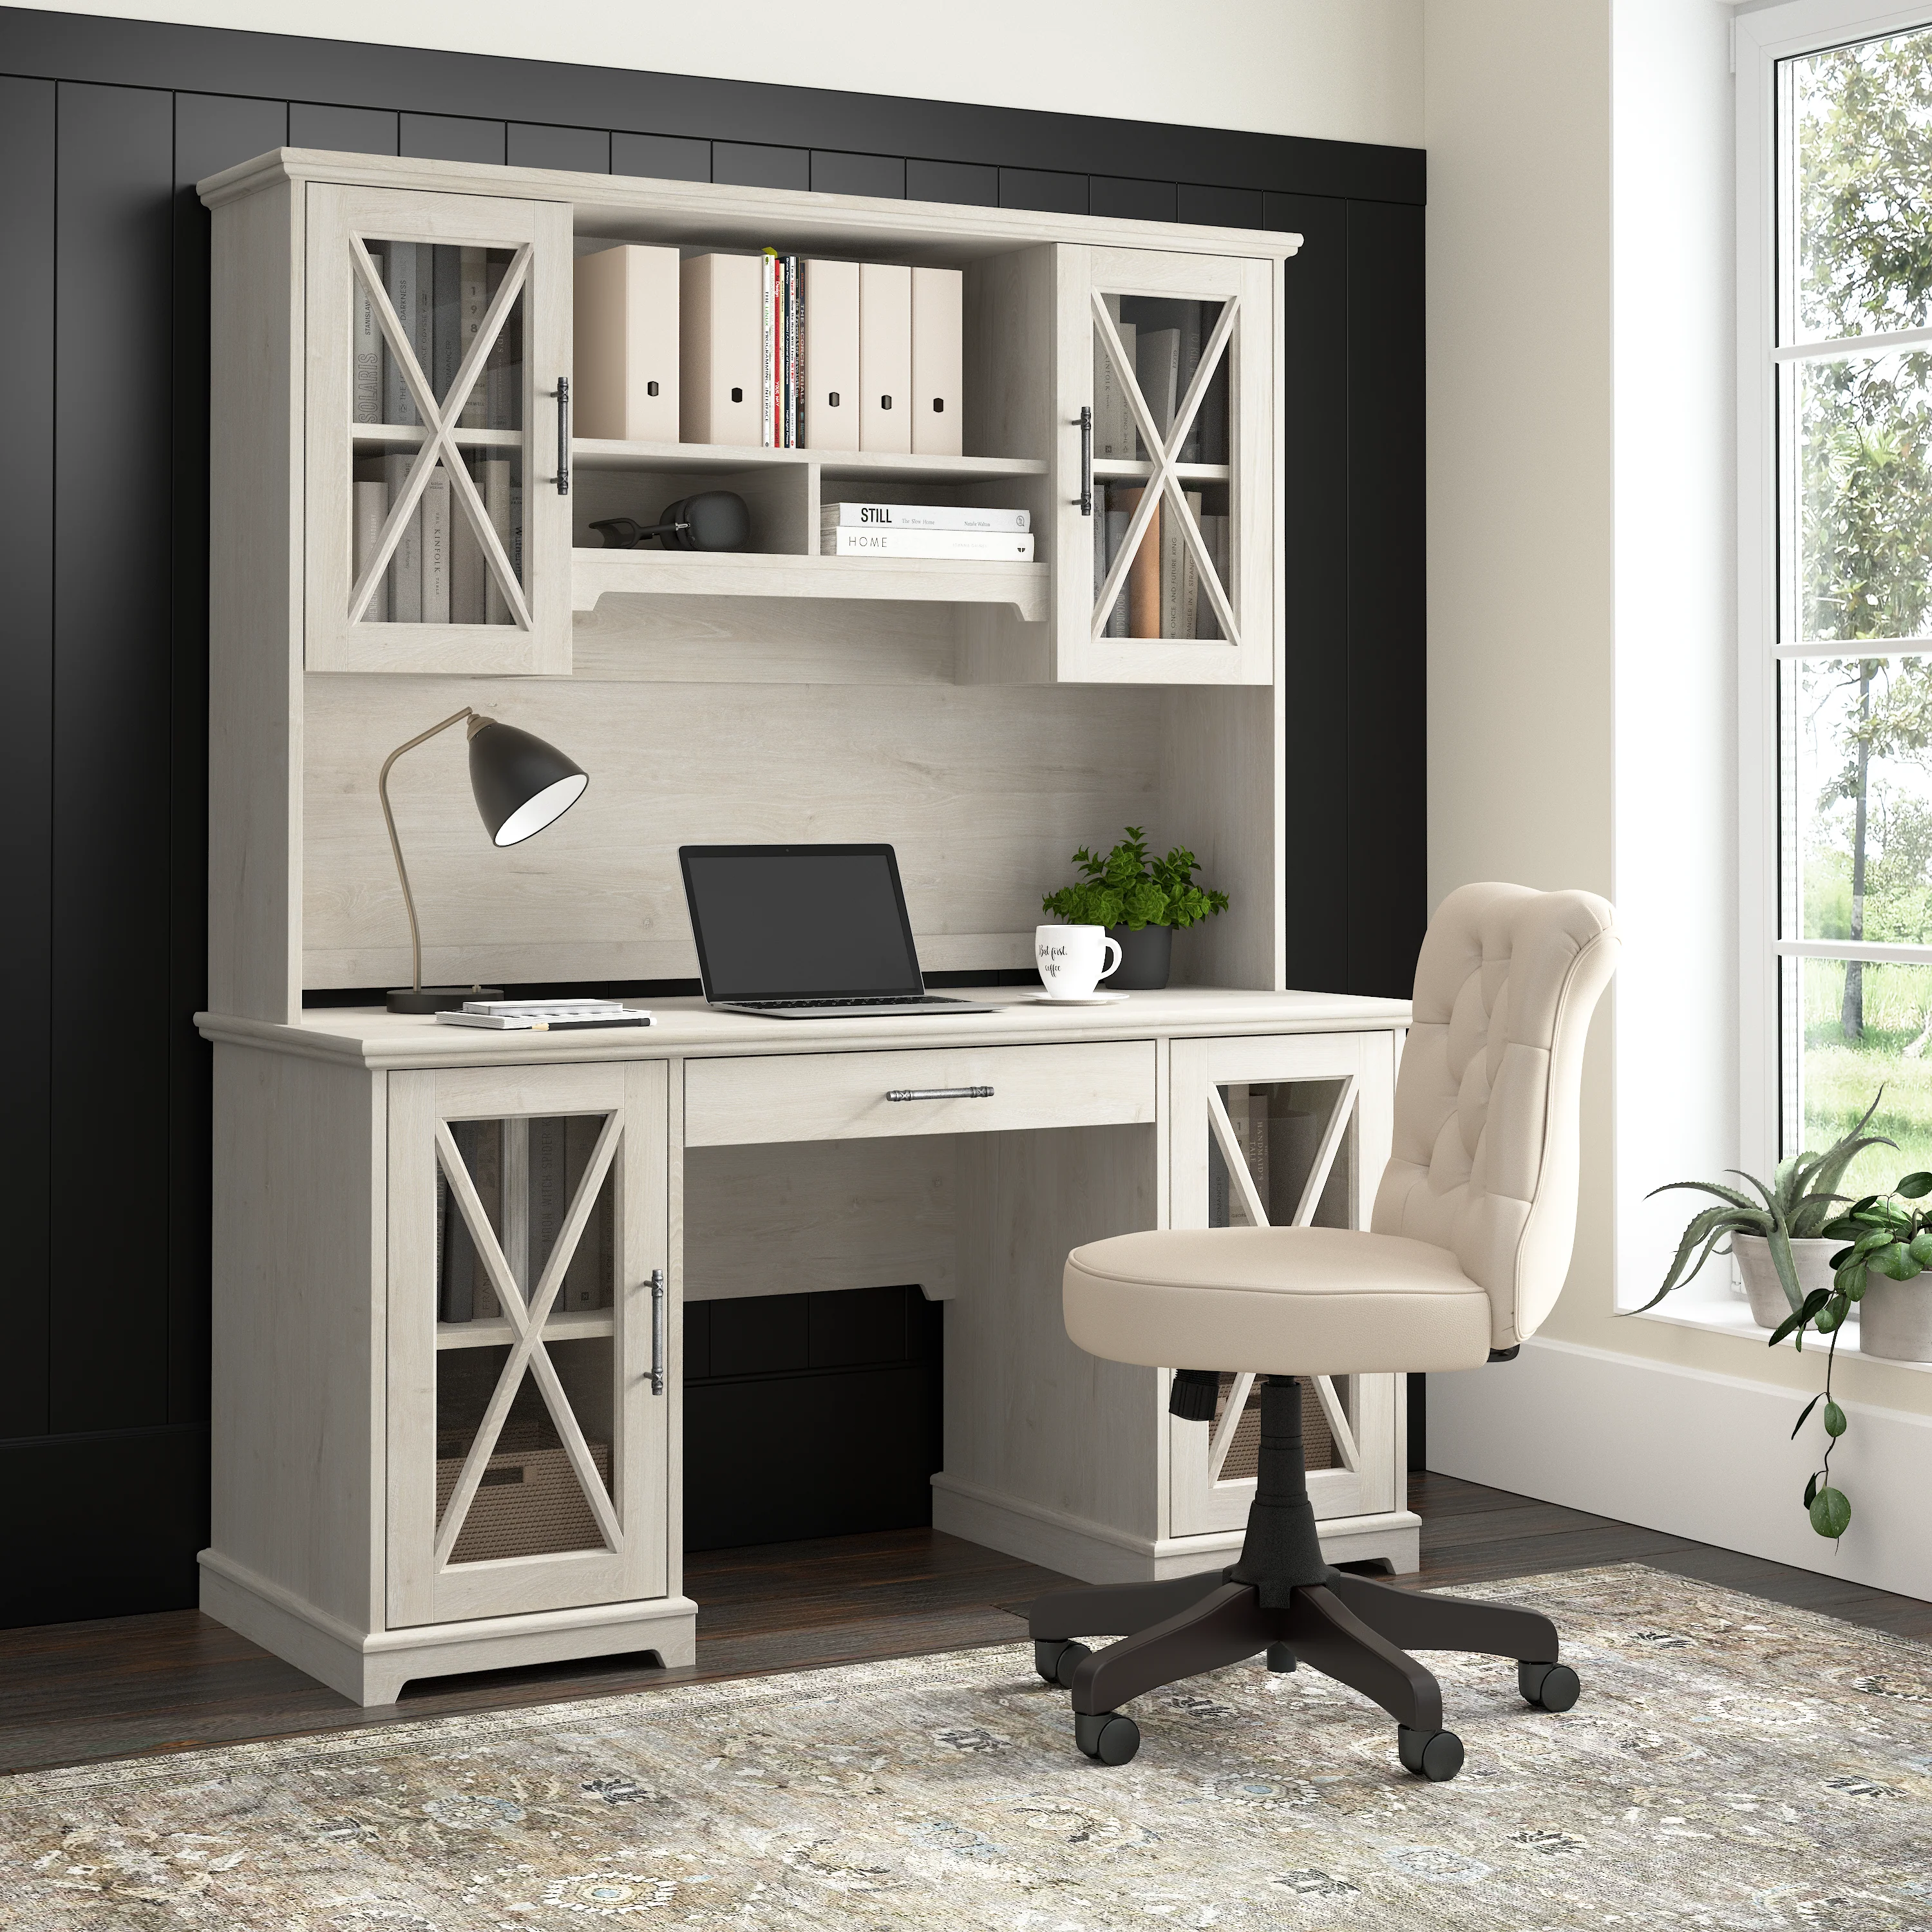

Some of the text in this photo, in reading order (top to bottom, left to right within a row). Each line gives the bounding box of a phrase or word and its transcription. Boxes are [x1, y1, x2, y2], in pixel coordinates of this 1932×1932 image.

[358, 353, 378, 424] SOLARIS
[861, 507, 892, 523] STILL
[849, 536, 887, 547] HOME
[1116, 594, 1126, 638] MOCKINGBIR
[1039, 944, 1050, 957] But
[1045, 964, 1061, 978] coffee
[542, 1133, 553, 1169] SPIDER
[542, 1175, 552, 1207] WITCH
[542, 1213, 553, 1242] MOON
